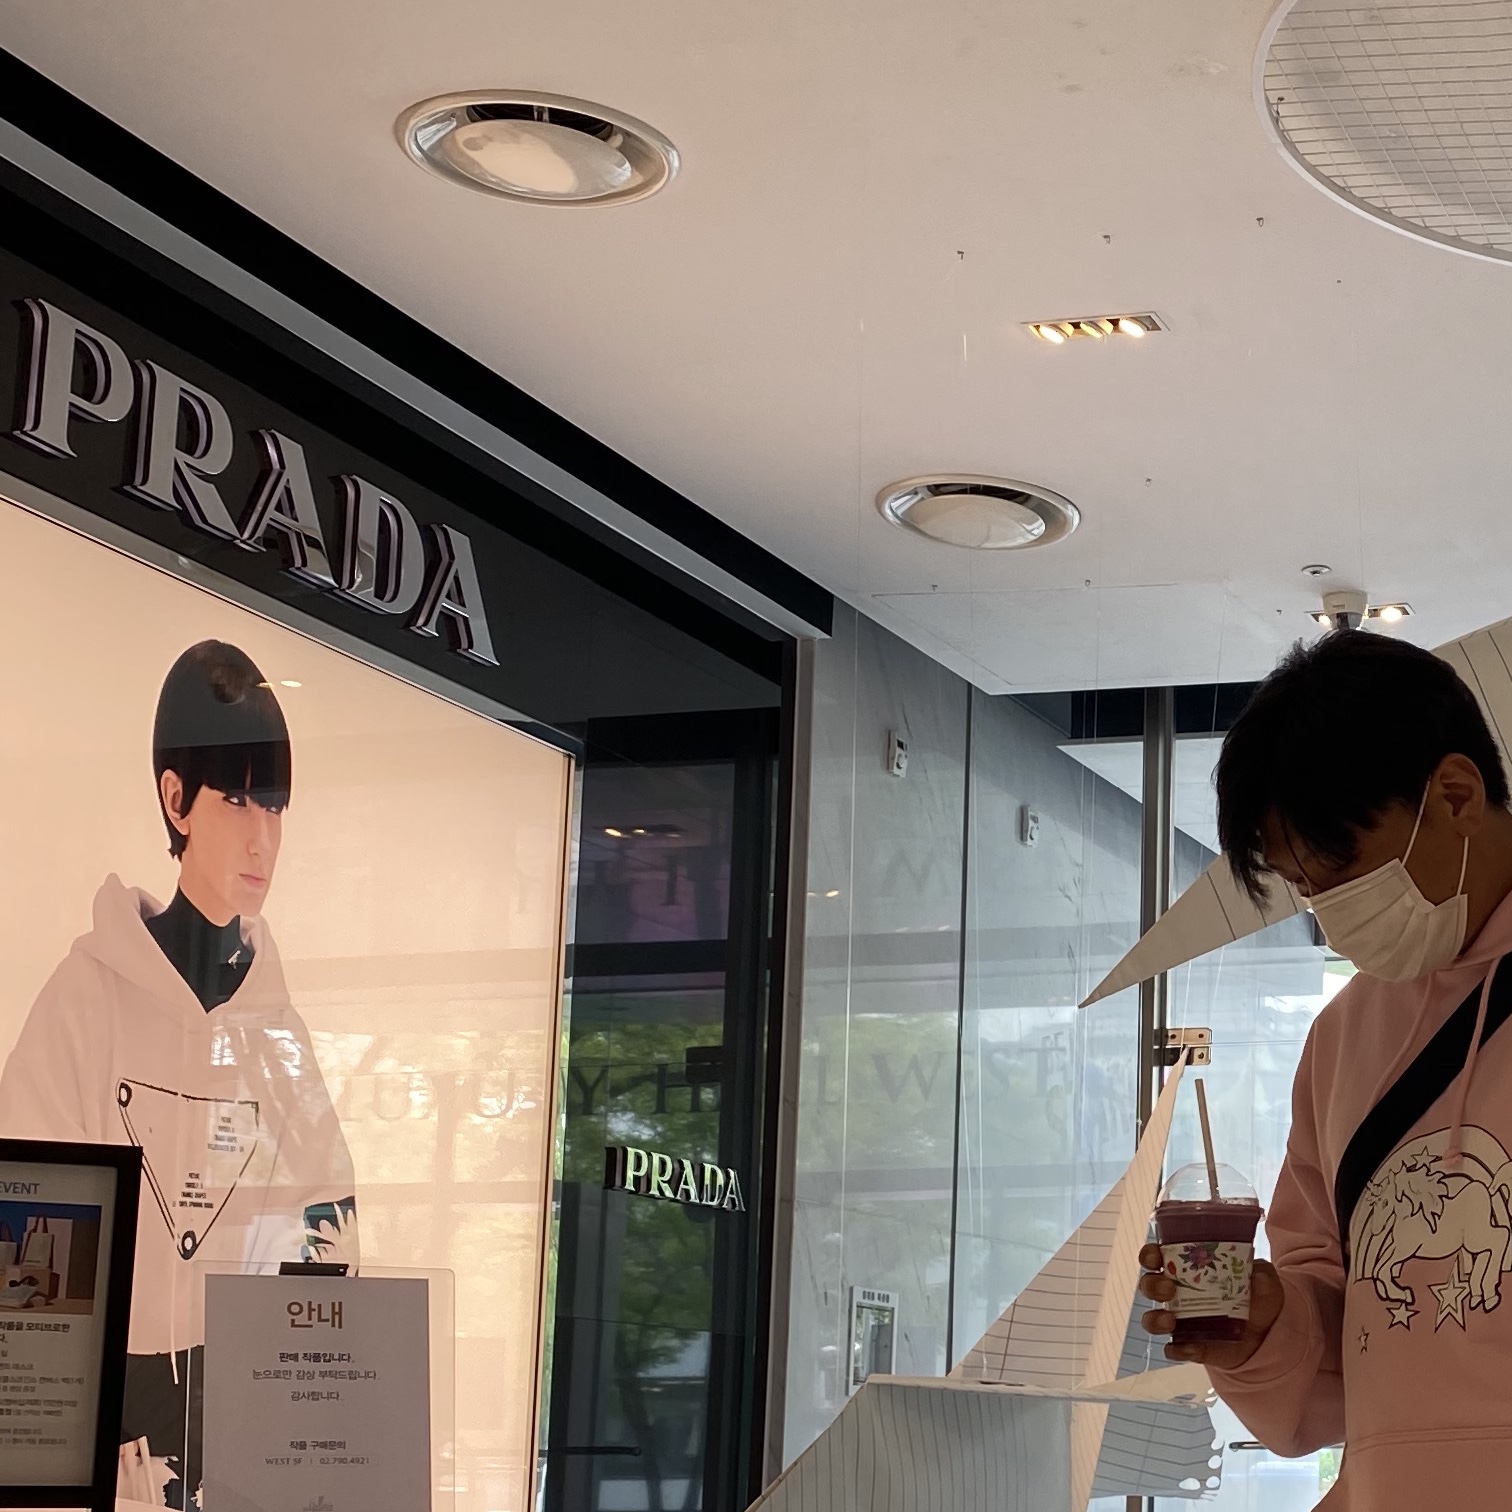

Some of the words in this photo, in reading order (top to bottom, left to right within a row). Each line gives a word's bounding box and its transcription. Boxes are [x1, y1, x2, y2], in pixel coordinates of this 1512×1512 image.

[13, 297, 500, 666] PRADA
[617, 1146, 746, 1213] PRADA
[286, 1301, 343, 1330] 안내
[278, 1352, 299, 1363] 판매
